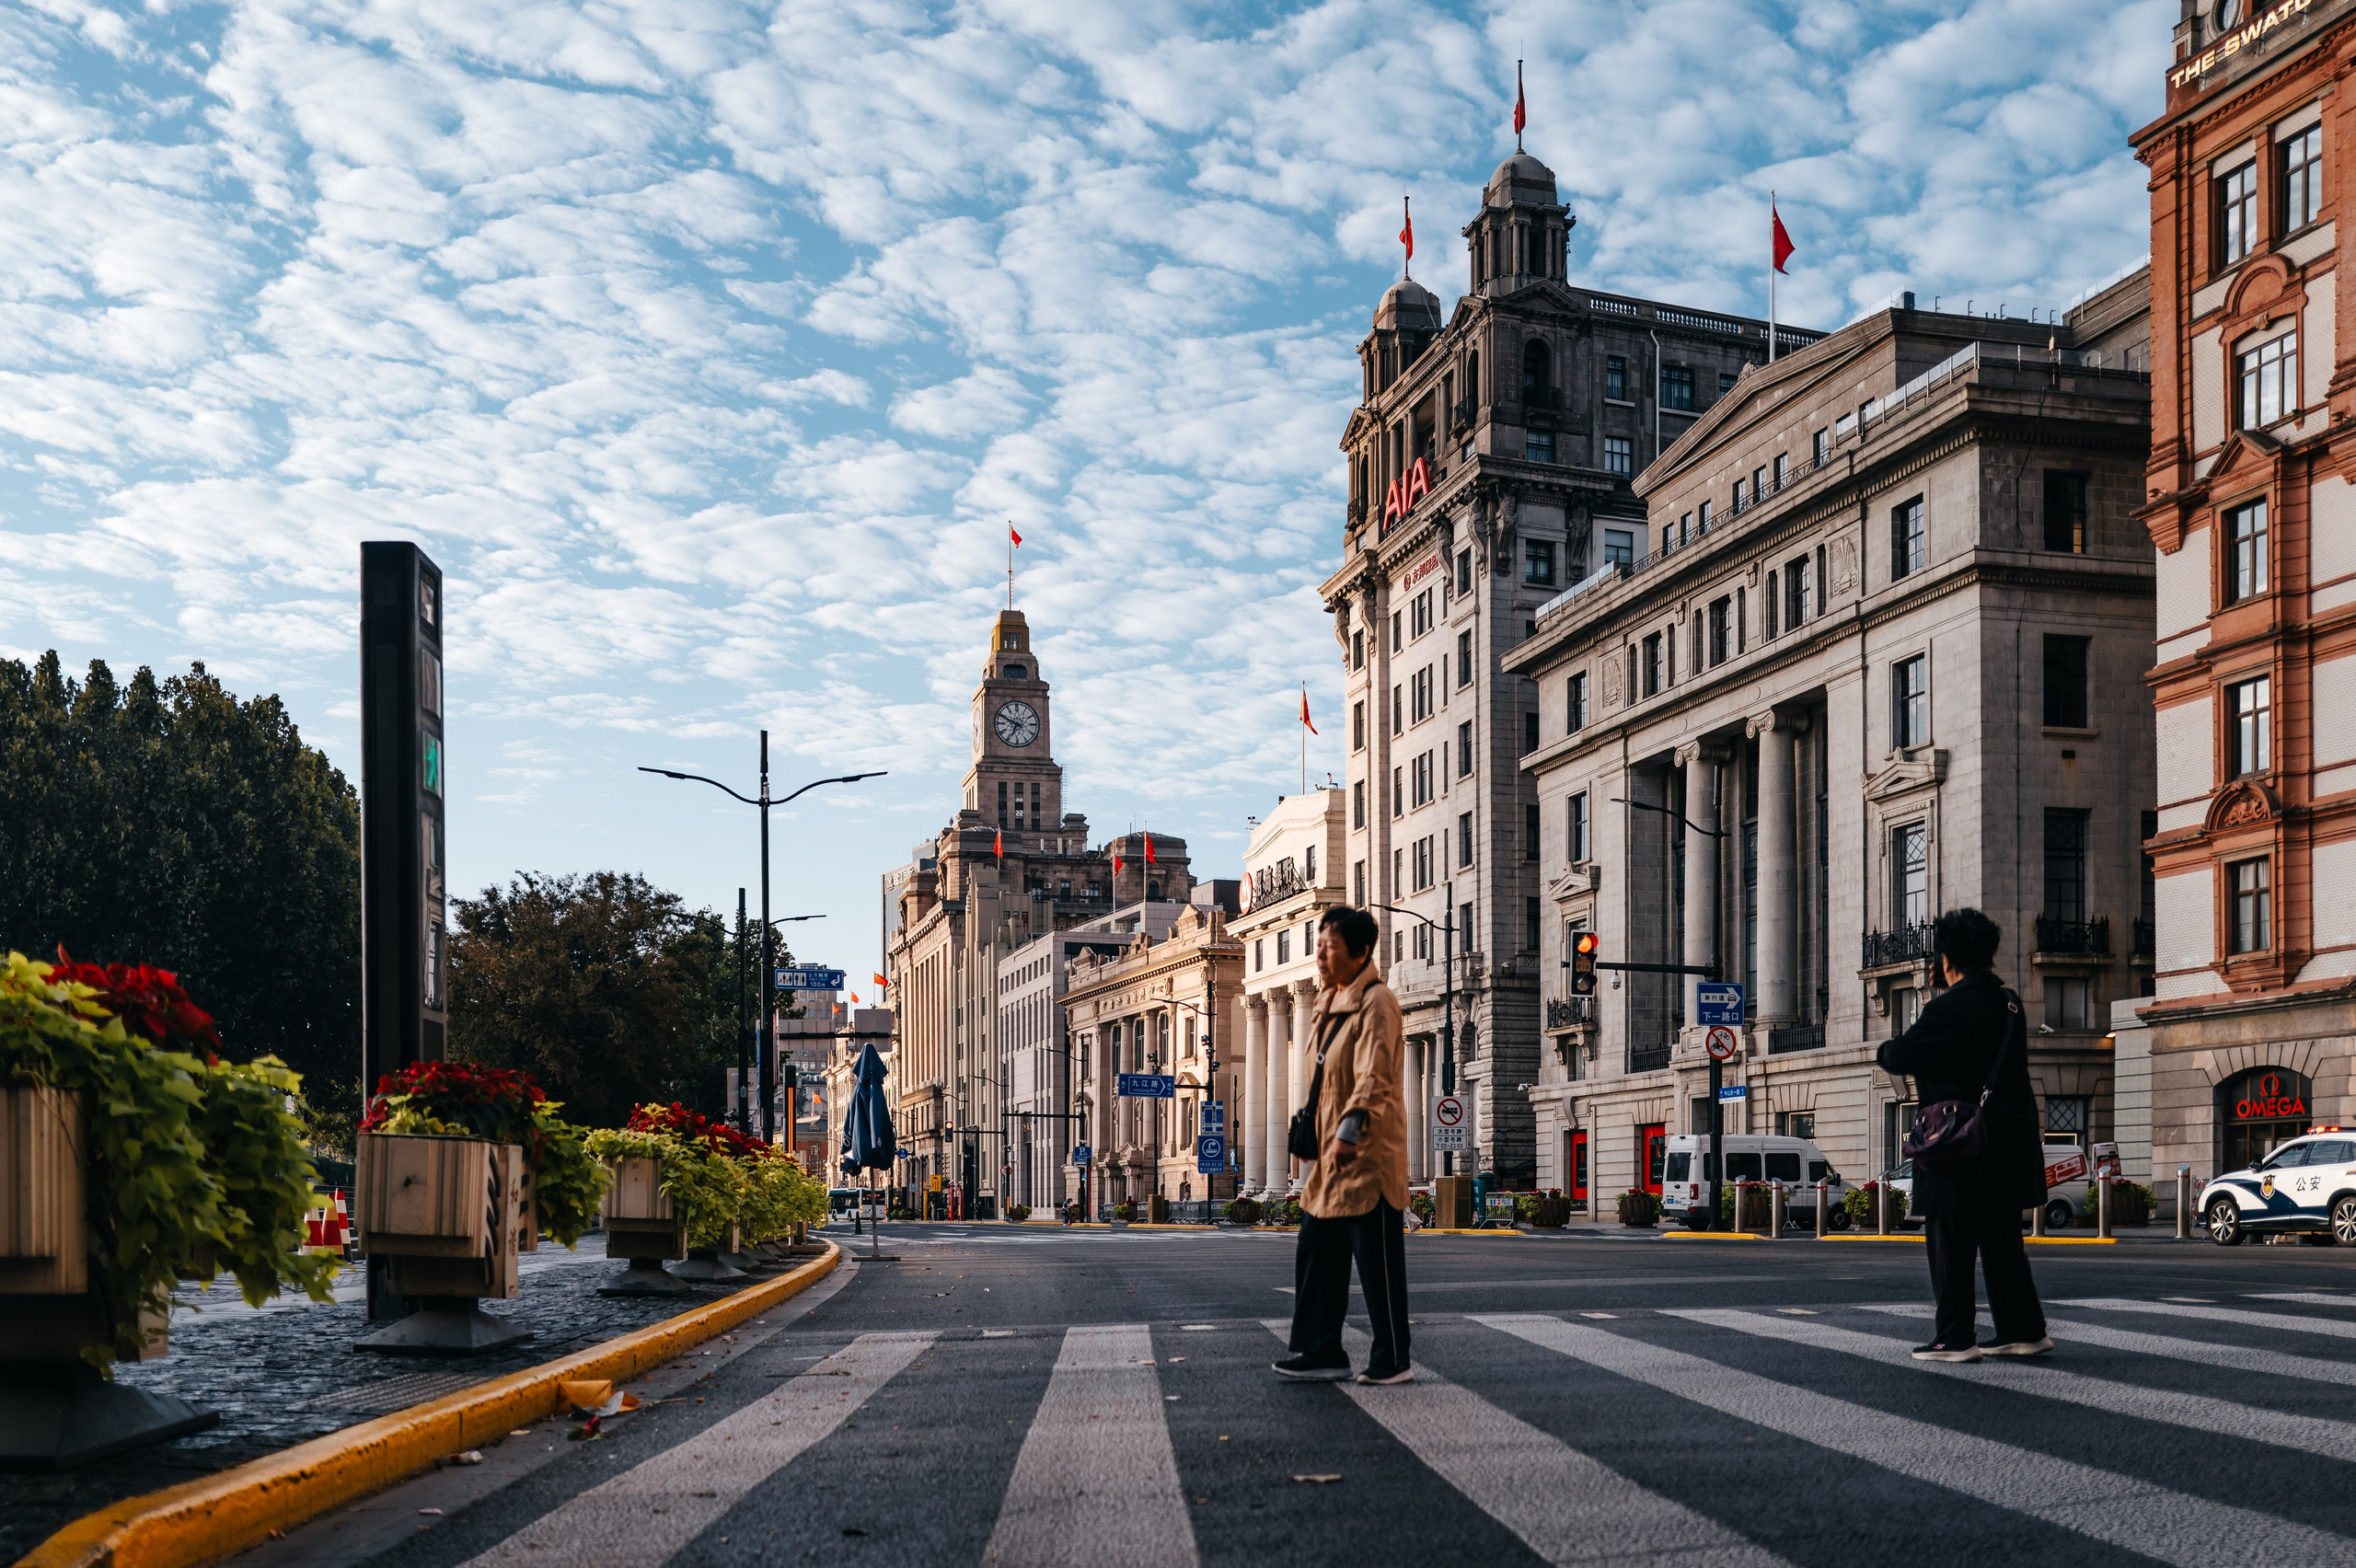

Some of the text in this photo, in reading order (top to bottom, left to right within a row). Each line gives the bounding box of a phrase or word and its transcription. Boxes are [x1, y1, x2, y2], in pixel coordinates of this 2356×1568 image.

[2171, 49, 2215, 89] THE
[1382, 456, 1432, 533] AIA
[1703, 1011, 1738, 1021] 下一路口
[1132, 1079, 1159, 1088] 九江路
[2236, 1096, 2305, 1119] OMEGA
[2295, 1175, 2321, 1192] 公安
